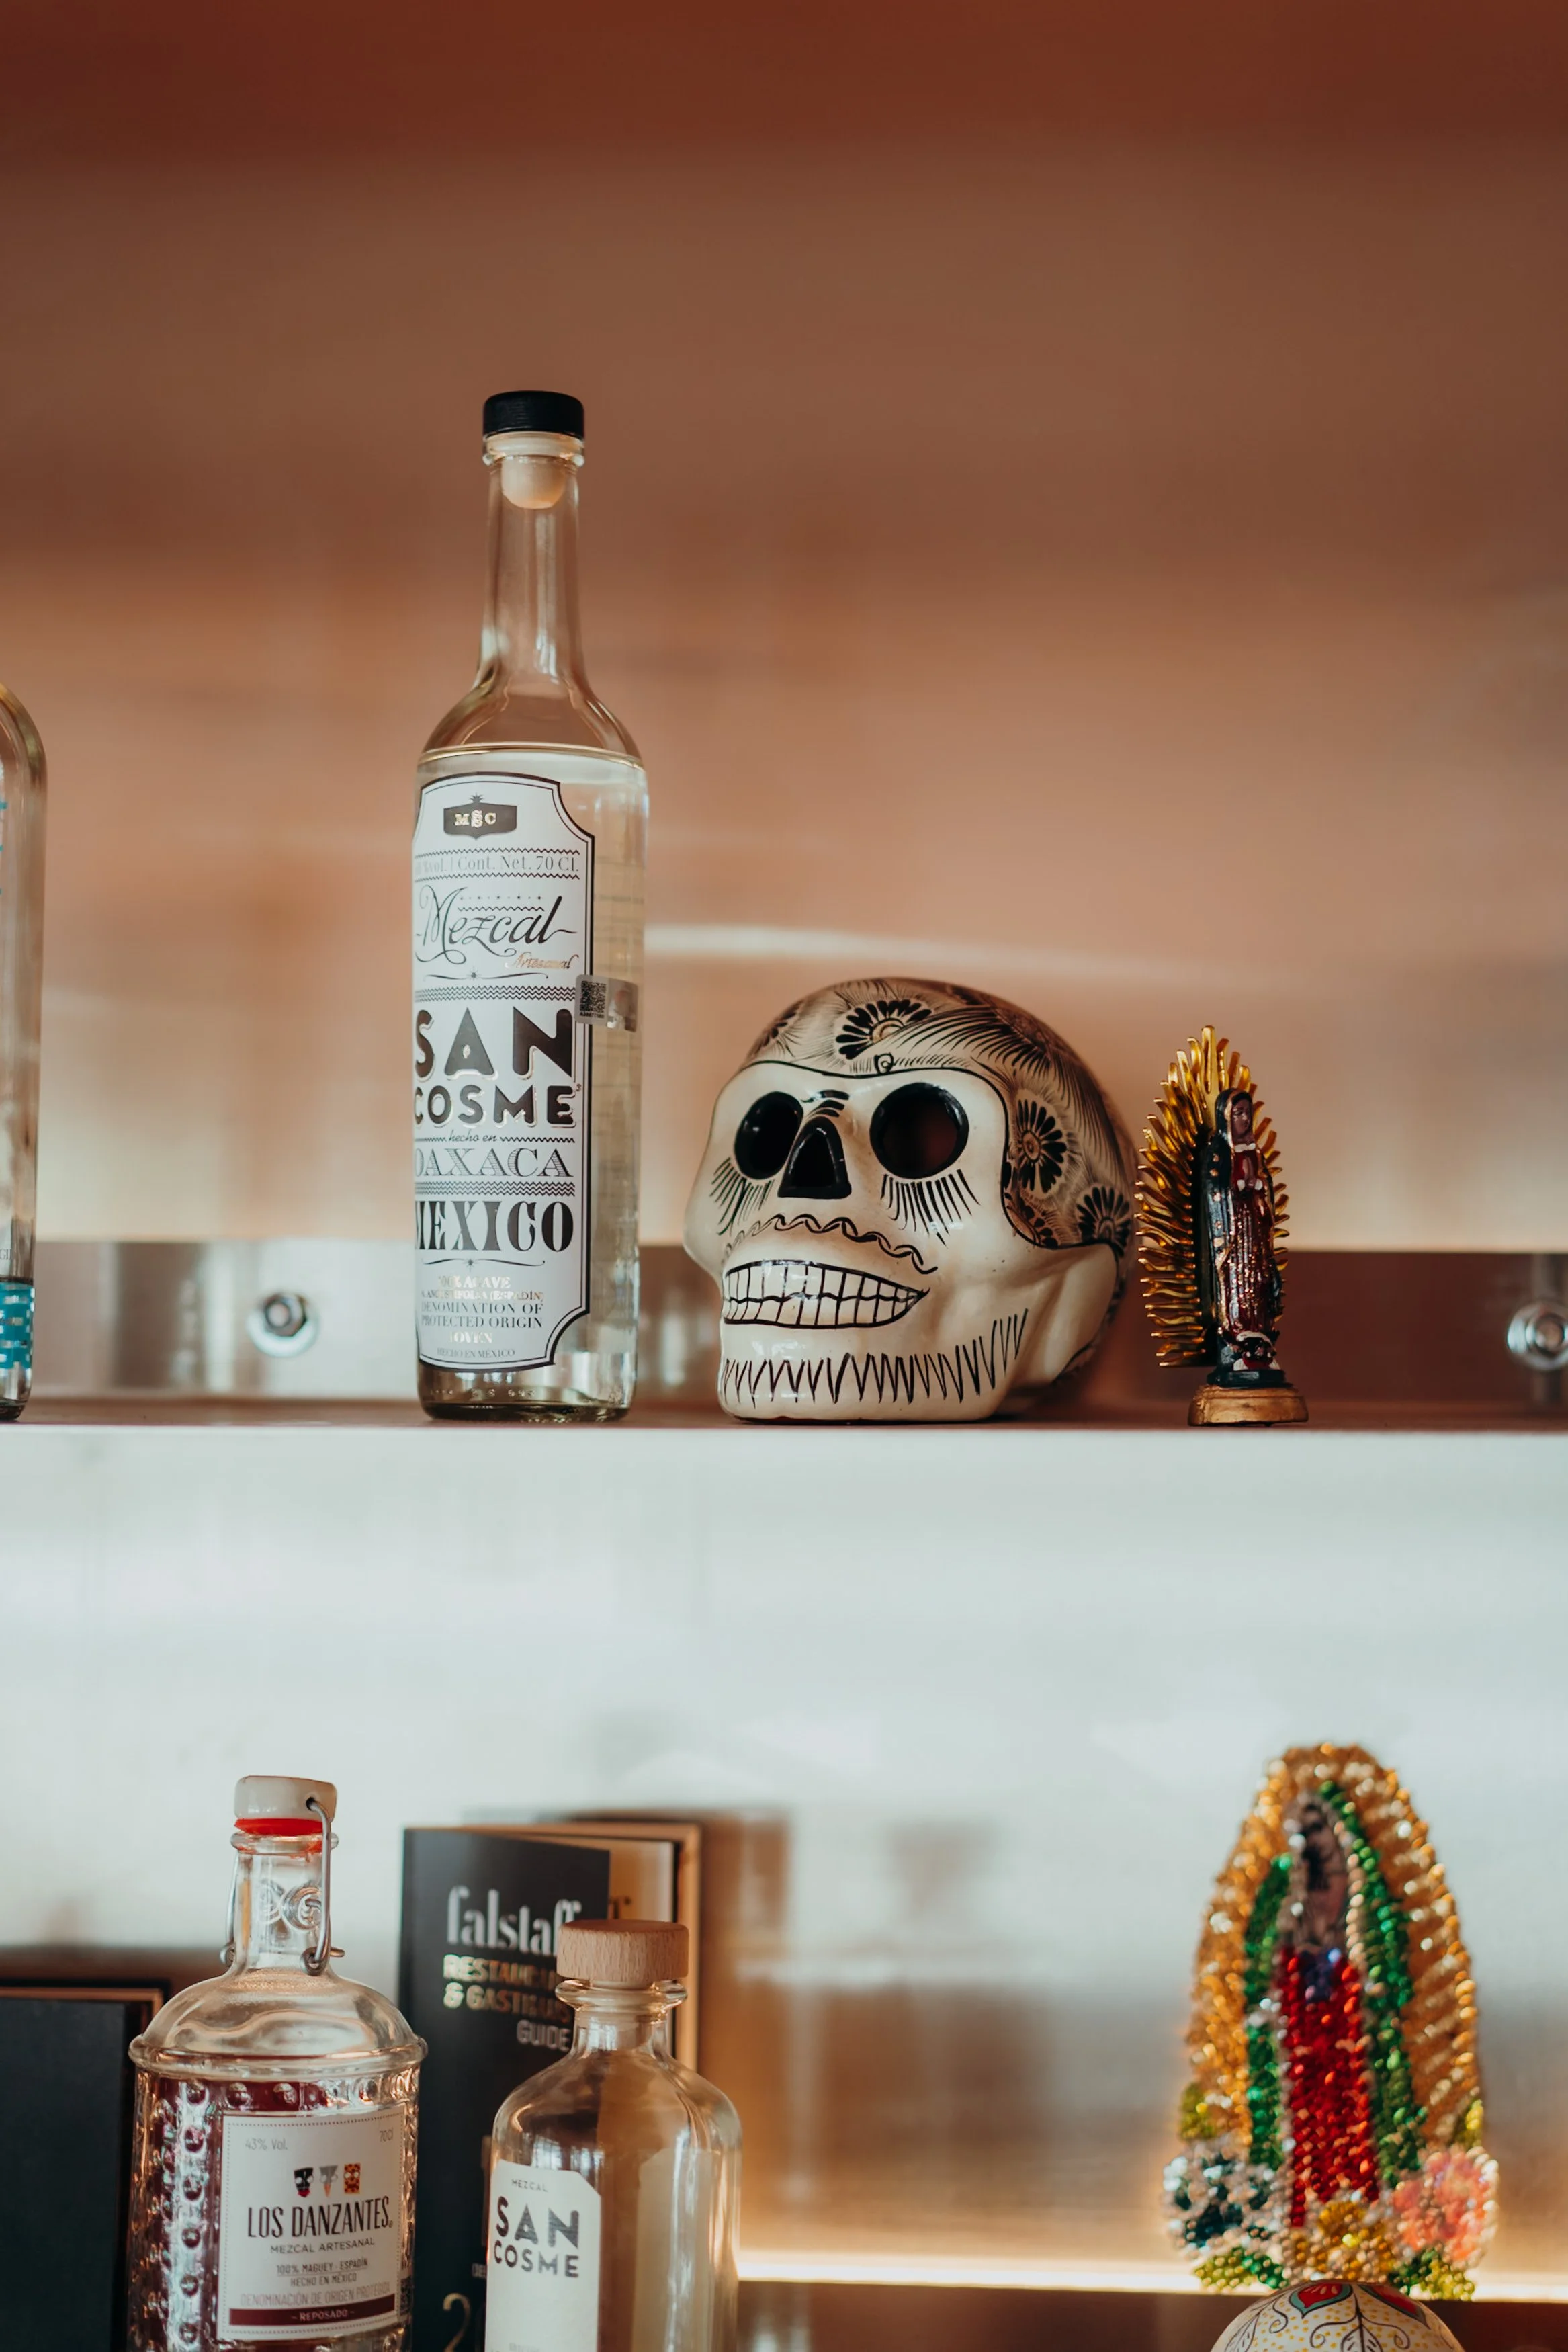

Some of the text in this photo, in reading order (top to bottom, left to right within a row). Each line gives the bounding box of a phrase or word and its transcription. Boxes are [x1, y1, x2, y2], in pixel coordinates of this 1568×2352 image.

[458, 855, 495, 872] Cont.
[500, 855, 531, 870] Net.
[536, 855, 554, 870] 70
[415, 885, 577, 964] Mezcal
[415, 1007, 574, 1079] SAN
[414, 1084, 576, 1126] COSME
[448, 1130, 479, 1142] hecho
[415, 1148, 574, 1177] OAXACA
[421, 1301, 543, 1314] DENOMINATION OF
[421, 1314, 543, 1328] PROTECTED ORIGIN
[437, 1348, 463, 1357] HECHO
[465, 1349, 476, 1357] EN
[443, 1982, 464, 2009] &
[517, 2019, 571, 2052] GUIDE
[511, 2178, 548, 2192] MEZCAL
[247, 2195, 389, 2238] LOS DANZANTES
[496, 2195, 580, 2249] SAN
[270, 2237, 375, 2253] MEZCAL ARTESANAL
[494, 2240, 580, 2278] COSME
[277, 2263, 299, 2274] 100%
[302, 2262, 334, 2272] MAGUEY
[290, 2273, 357, 2287] HECHO EN MÉXICO
[311, 2292, 322, 2304] DE
[325, 2286, 355, 2302] ORIGEN
[300, 2308, 349, 2321] REPOSADO
